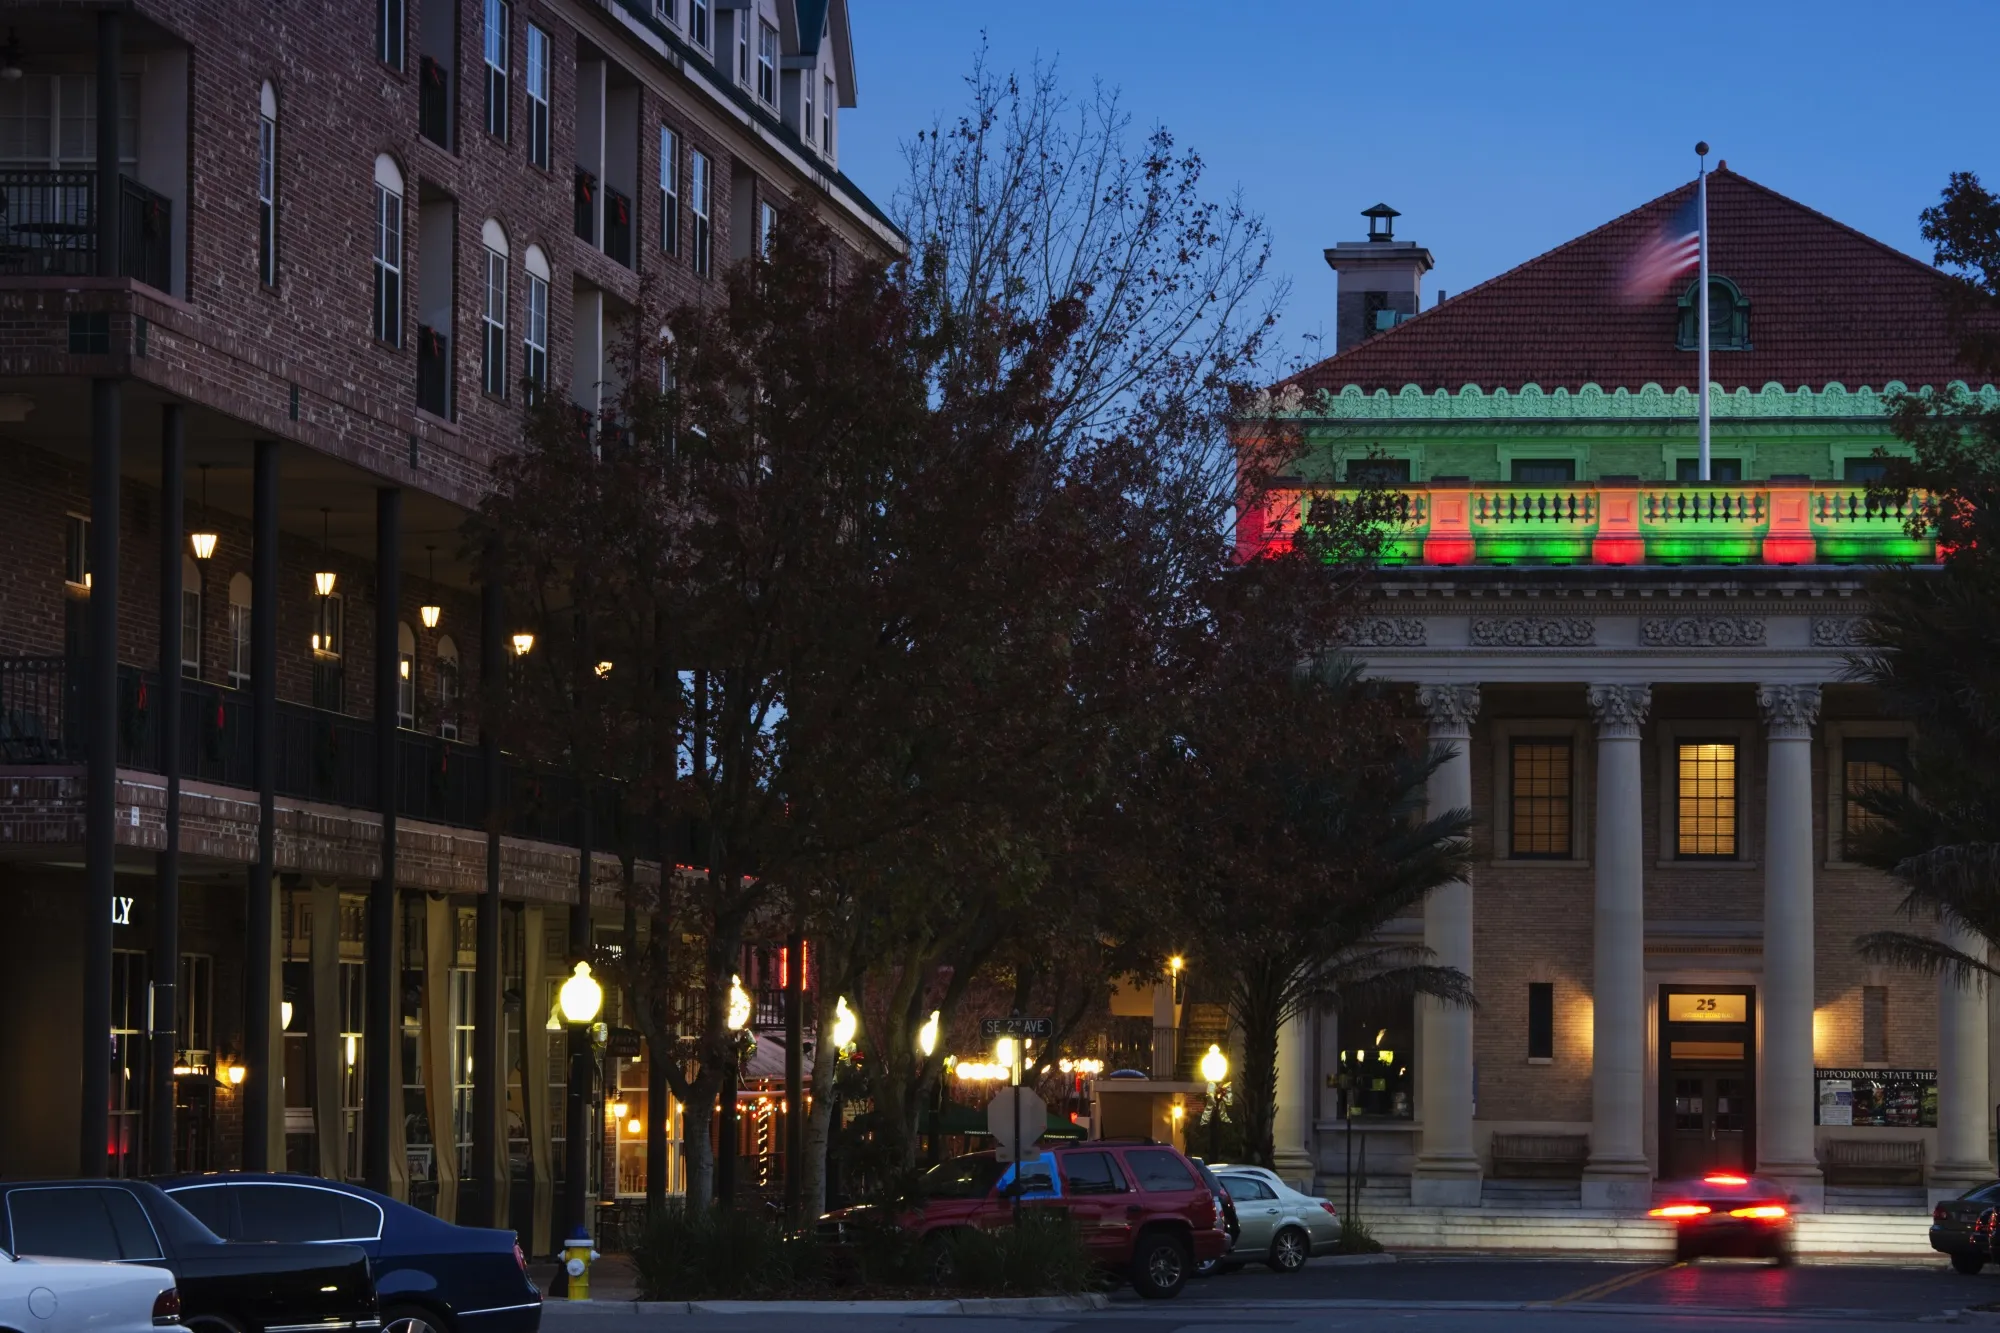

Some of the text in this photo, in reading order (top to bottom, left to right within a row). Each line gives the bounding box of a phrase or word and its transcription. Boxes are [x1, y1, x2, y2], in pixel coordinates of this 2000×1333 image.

[1696, 998, 1717, 1011] 25
[987, 1020, 1001, 1033] SE
[1024, 1020, 1044, 1033] AVE
[1881, 1071, 1912, 1080] STATE
